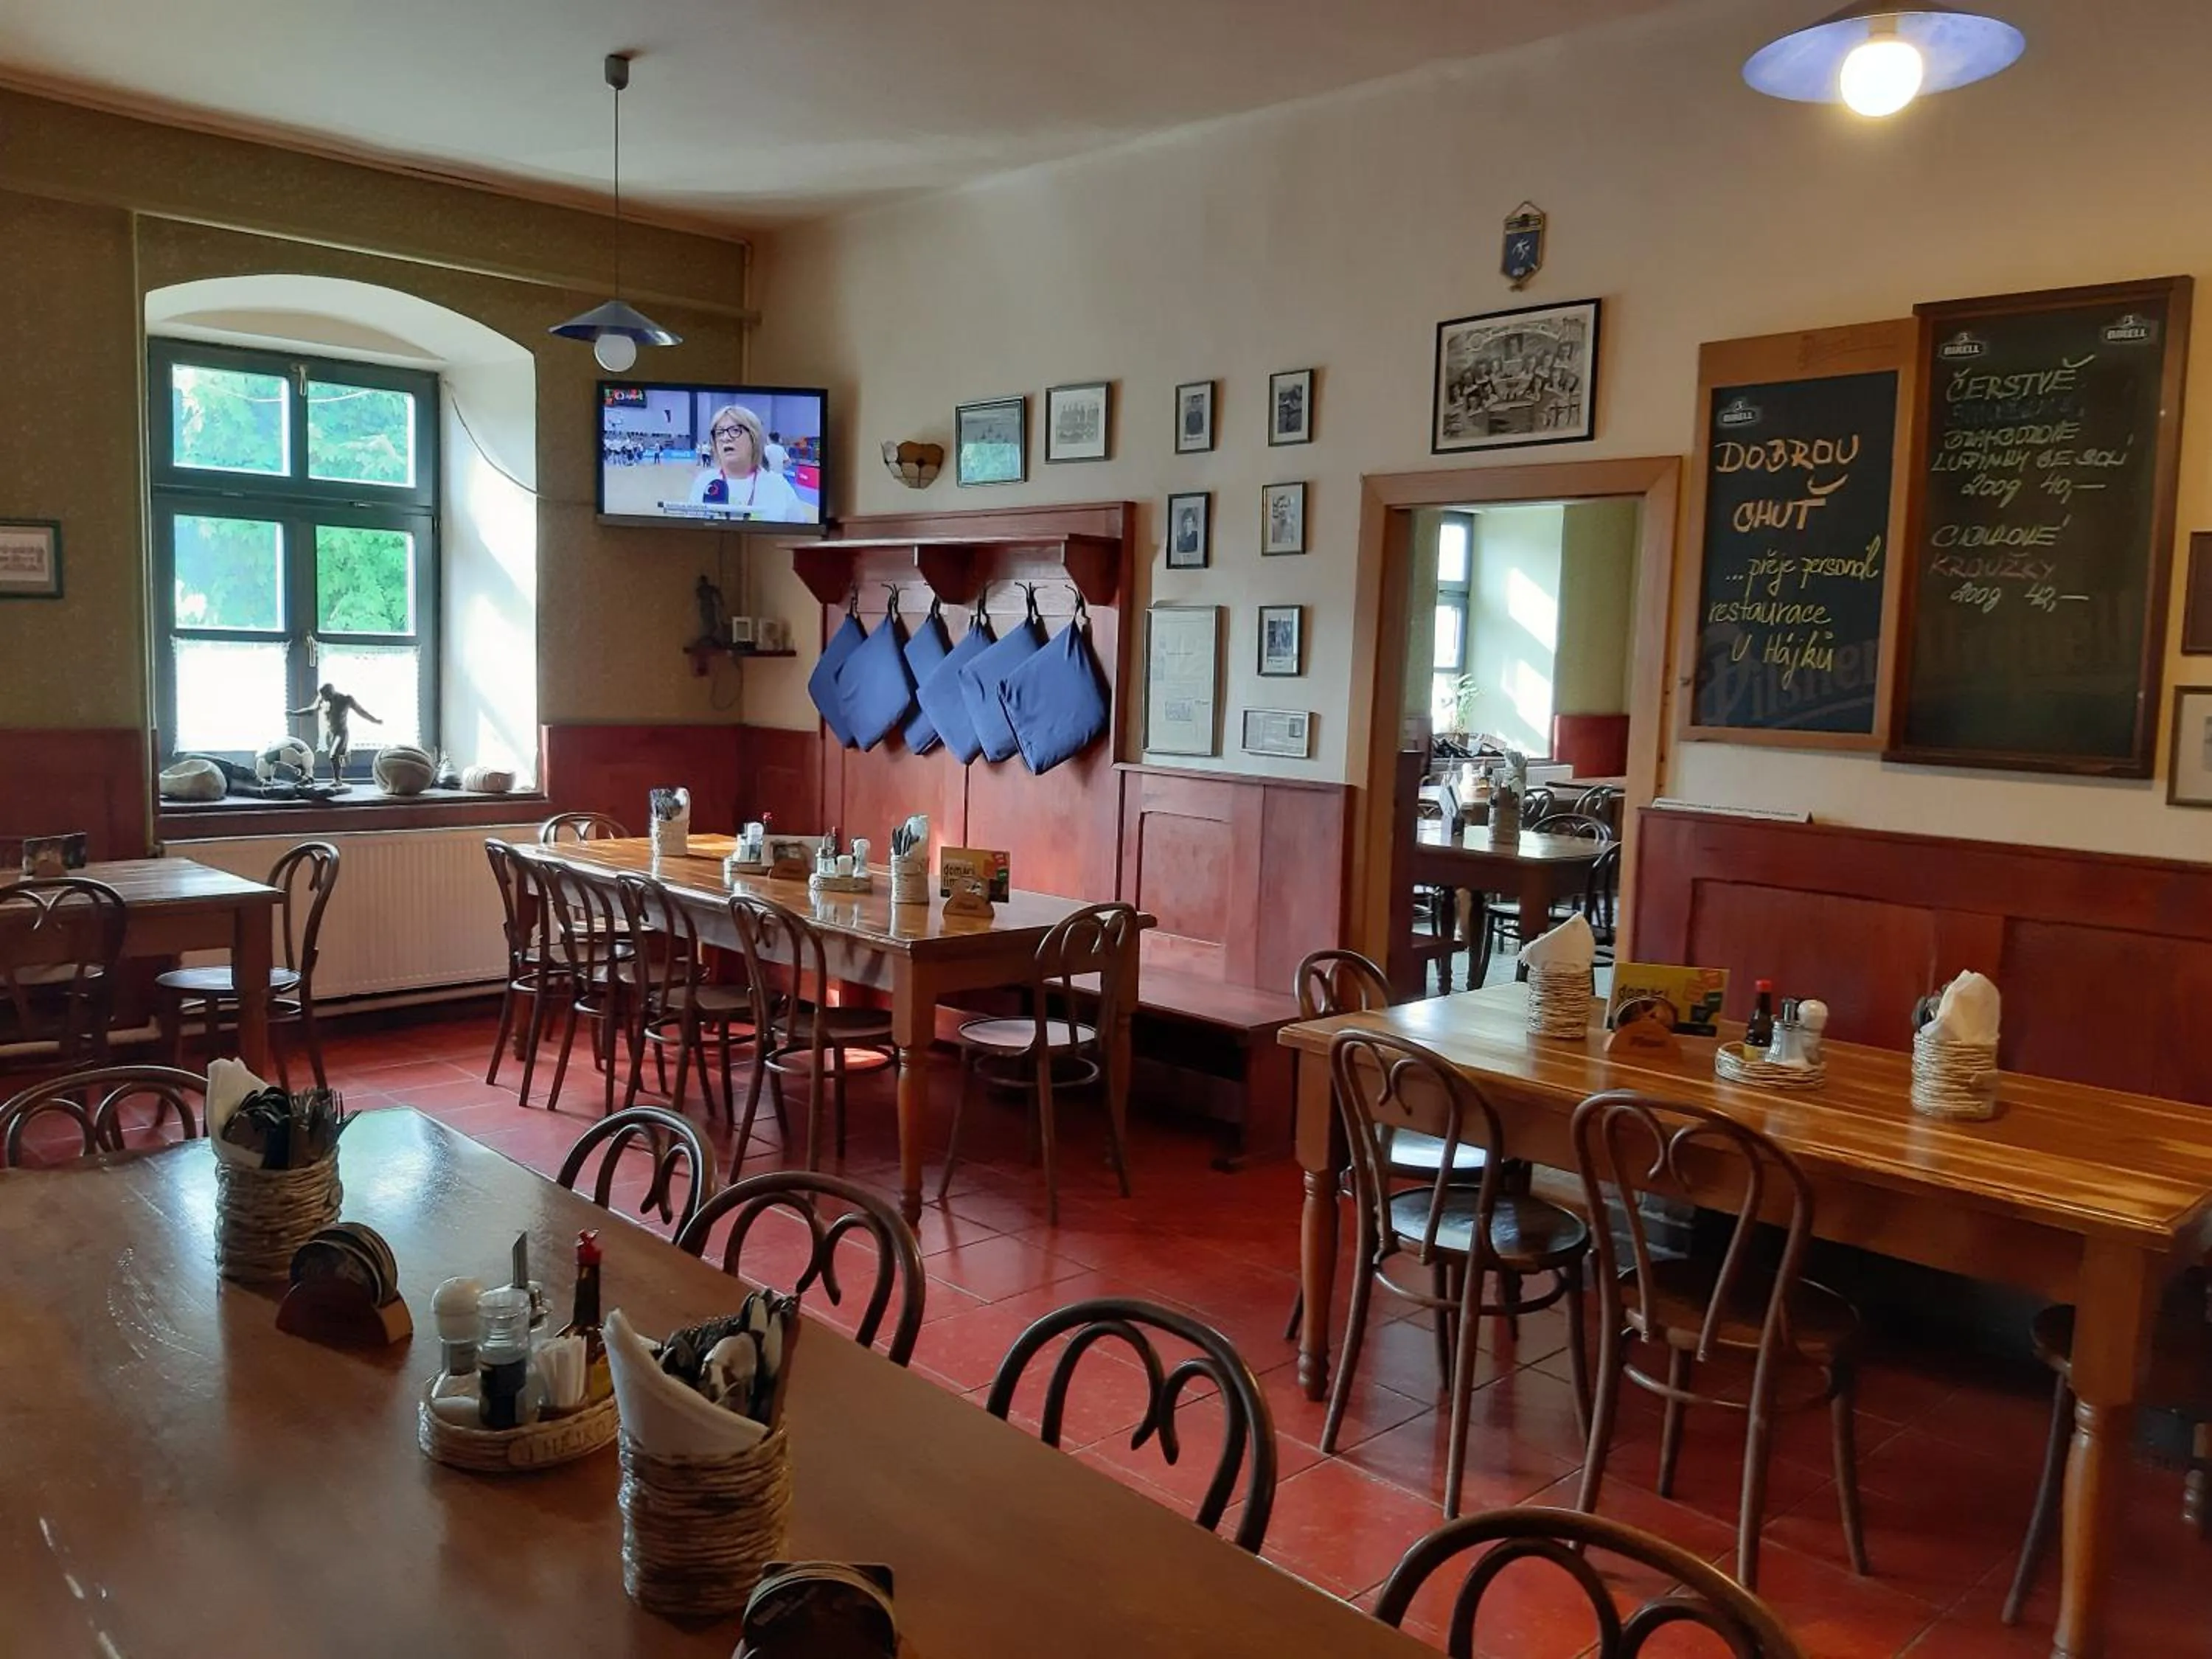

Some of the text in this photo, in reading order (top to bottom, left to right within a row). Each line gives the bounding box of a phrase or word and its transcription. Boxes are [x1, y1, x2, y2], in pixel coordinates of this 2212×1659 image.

[1715, 434, 1859, 473] DOBROU
[1733, 474, 1848, 533] CHUŤ
[1708, 600, 1832, 626] restaurace
[1732, 630, 1834, 690] U Hájků
